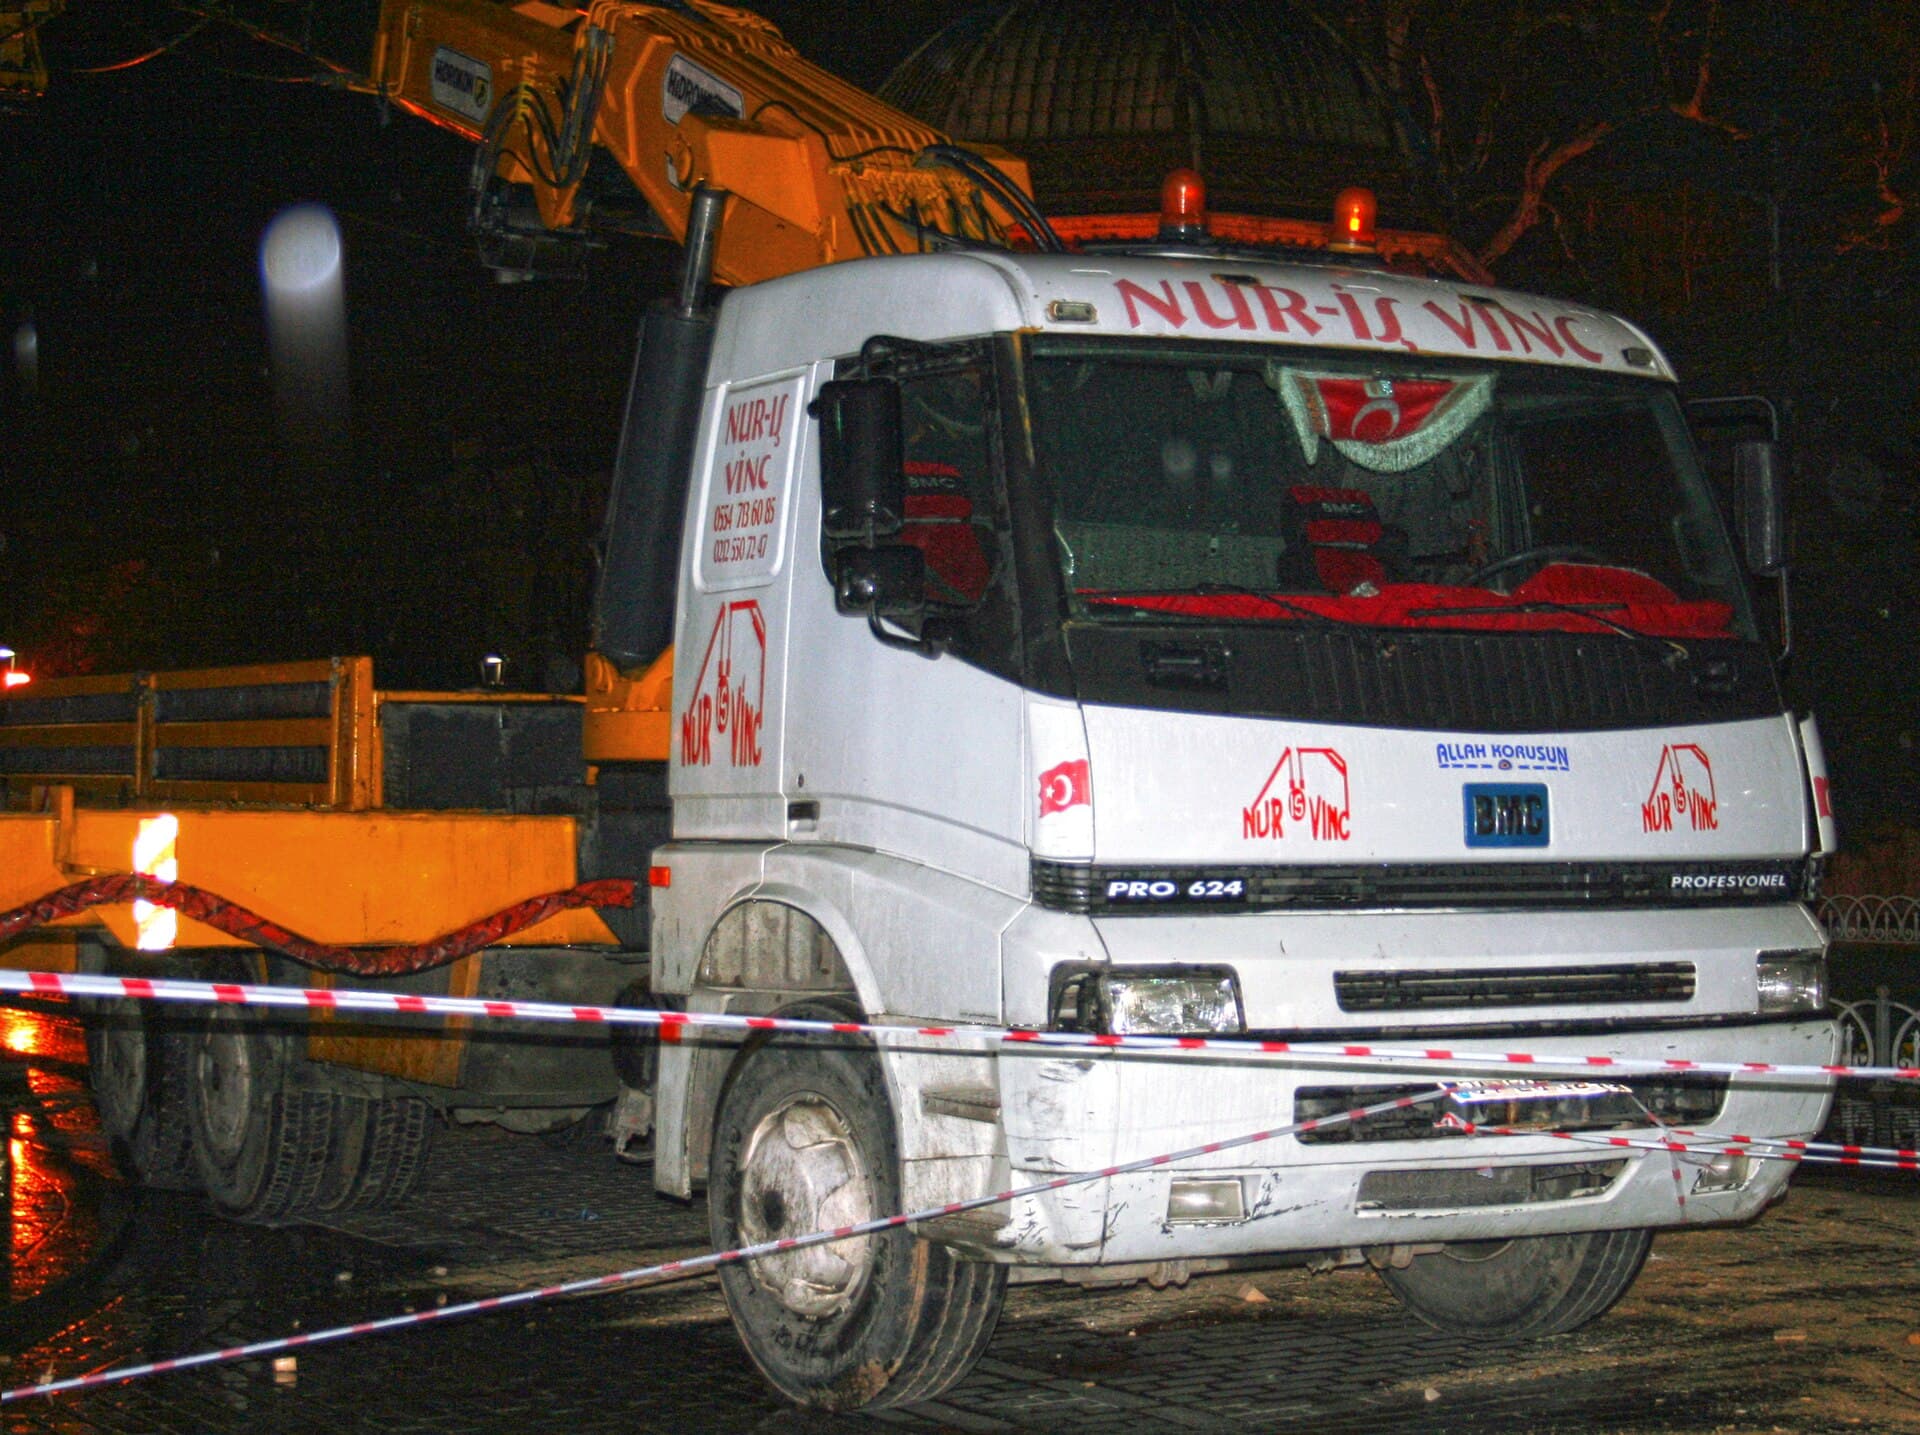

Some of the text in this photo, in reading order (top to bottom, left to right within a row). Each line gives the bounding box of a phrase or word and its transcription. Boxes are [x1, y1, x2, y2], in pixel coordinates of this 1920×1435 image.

[725, 450, 772, 495] VİNC
[681, 693, 712, 768] NUR
[1436, 743, 1569, 768] ALLAH KORUSUN
[1243, 797, 1284, 840] NUR
[1473, 794, 1543, 836] BMC
[1641, 792, 1673, 833] NUR
[1108, 880, 1243, 897] PRO 624
[1671, 874, 1786, 888] PROFESYONEL
